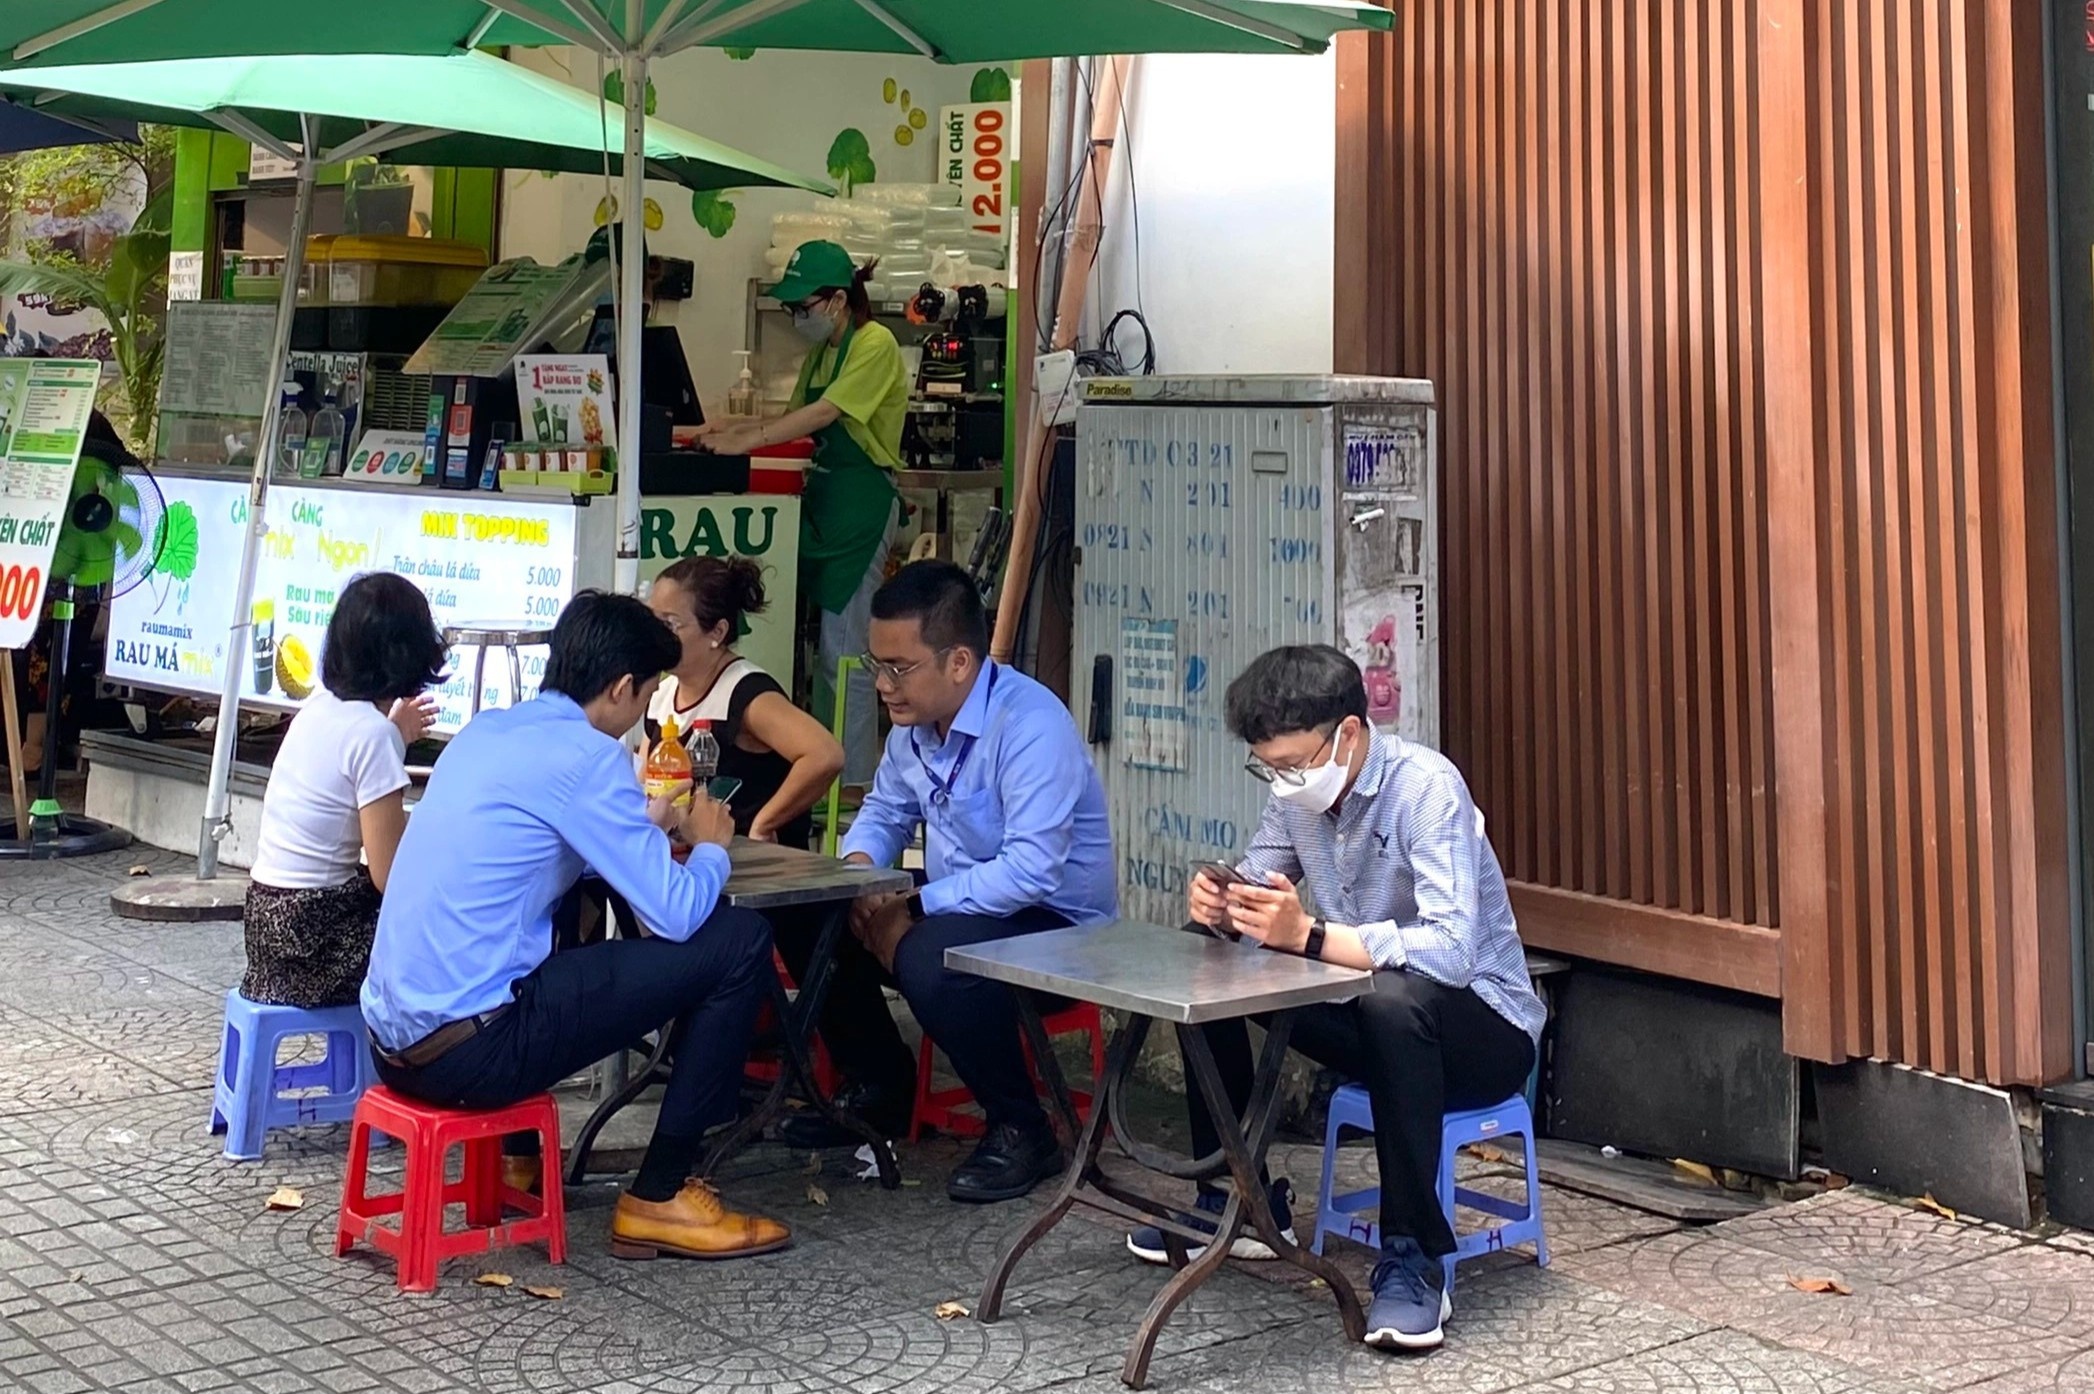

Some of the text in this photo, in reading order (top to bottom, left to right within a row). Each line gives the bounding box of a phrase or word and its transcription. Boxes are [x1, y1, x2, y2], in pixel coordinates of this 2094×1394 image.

[1086, 383, 1132, 396] Paradise
[462, 513, 550, 547] TOPPING
[640, 506, 778, 559] RAU
[526, 566, 561, 587] 5.000
[286, 584, 311, 603] Rau
[525, 595, 559, 617] 5.000
[141, 621, 193, 640] raumamix
[115, 639, 151, 666] RAU
[154, 641, 180, 672] MÁ
